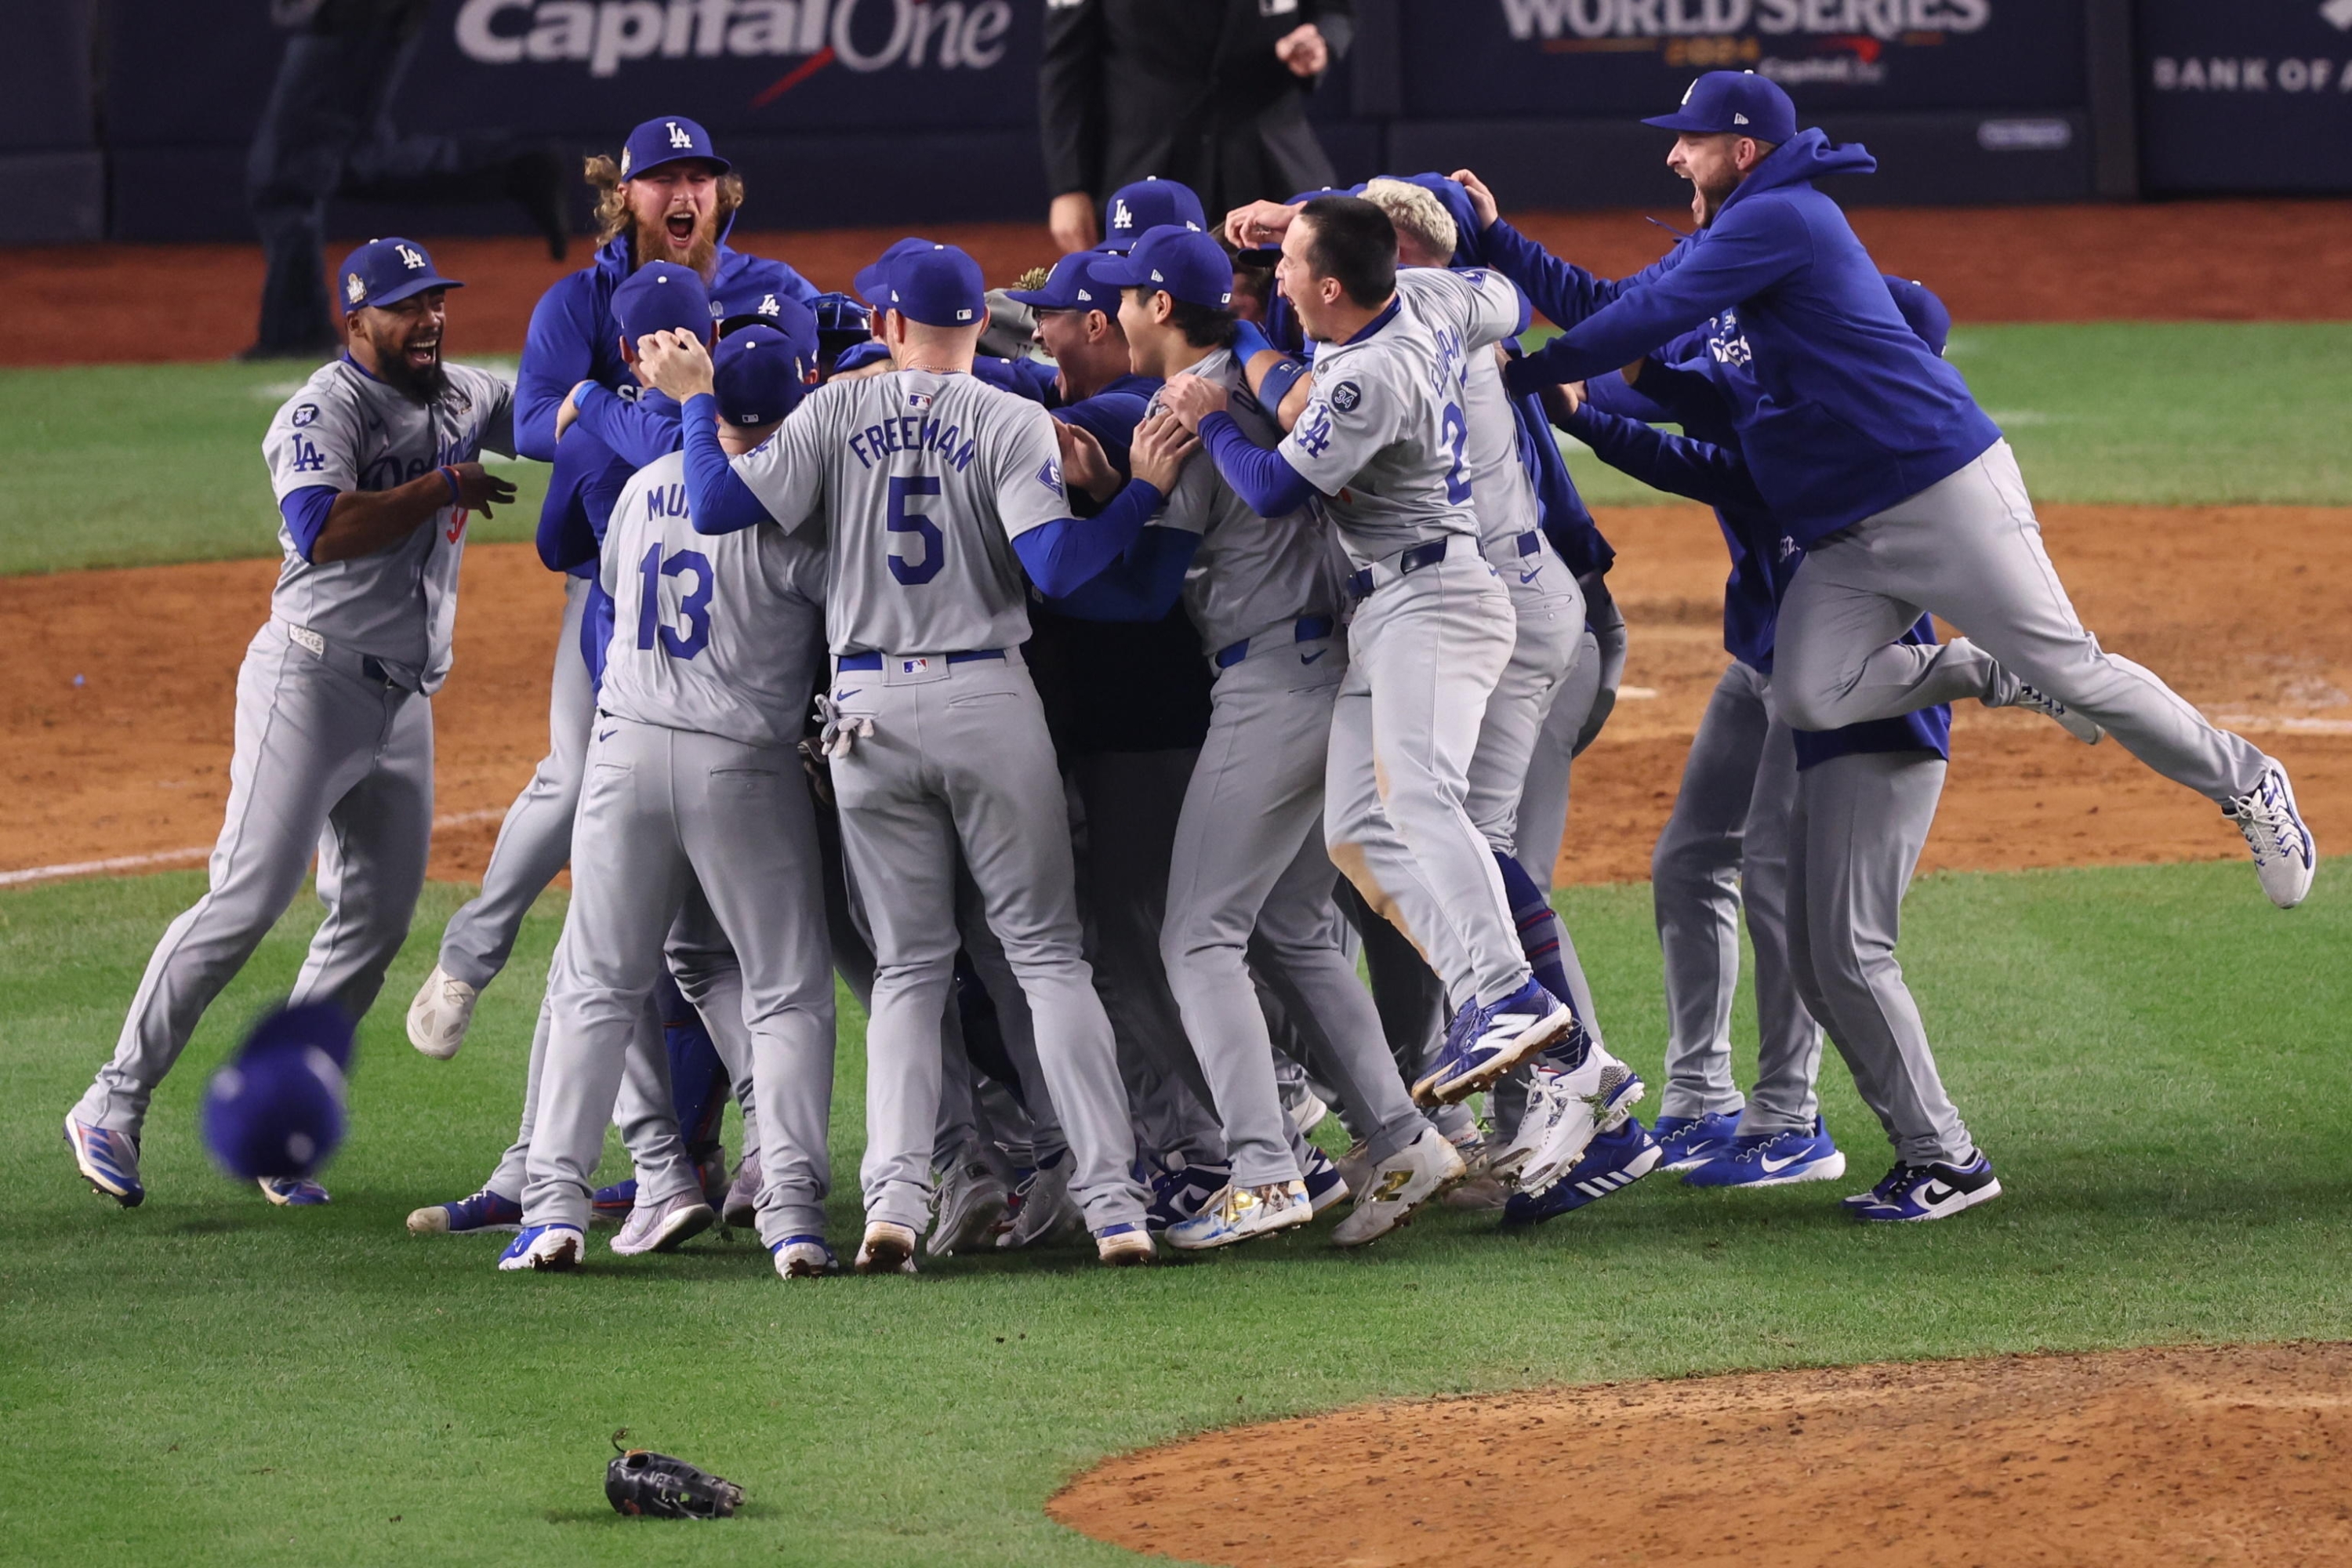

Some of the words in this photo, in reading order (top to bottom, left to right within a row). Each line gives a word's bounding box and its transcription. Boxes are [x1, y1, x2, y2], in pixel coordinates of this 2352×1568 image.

[1502, 0, 1749, 39] WORLD
[1754, 0, 1991, 40] SERIES
[2153, 56, 2269, 92] BANK
[2277, 56, 2333, 92] OF
[666, 122, 693, 149] LA
[1113, 198, 1133, 229] LA
[394, 244, 426, 270] LA
[758, 294, 781, 317] LA
[1334, 390, 1356, 409] 34
[849, 416, 975, 472] FREEMAN
[1298, 404, 1331, 459] LA
[292, 433, 325, 472] LA
[887, 476, 942, 585] 5
[637, 542, 713, 660] 13
